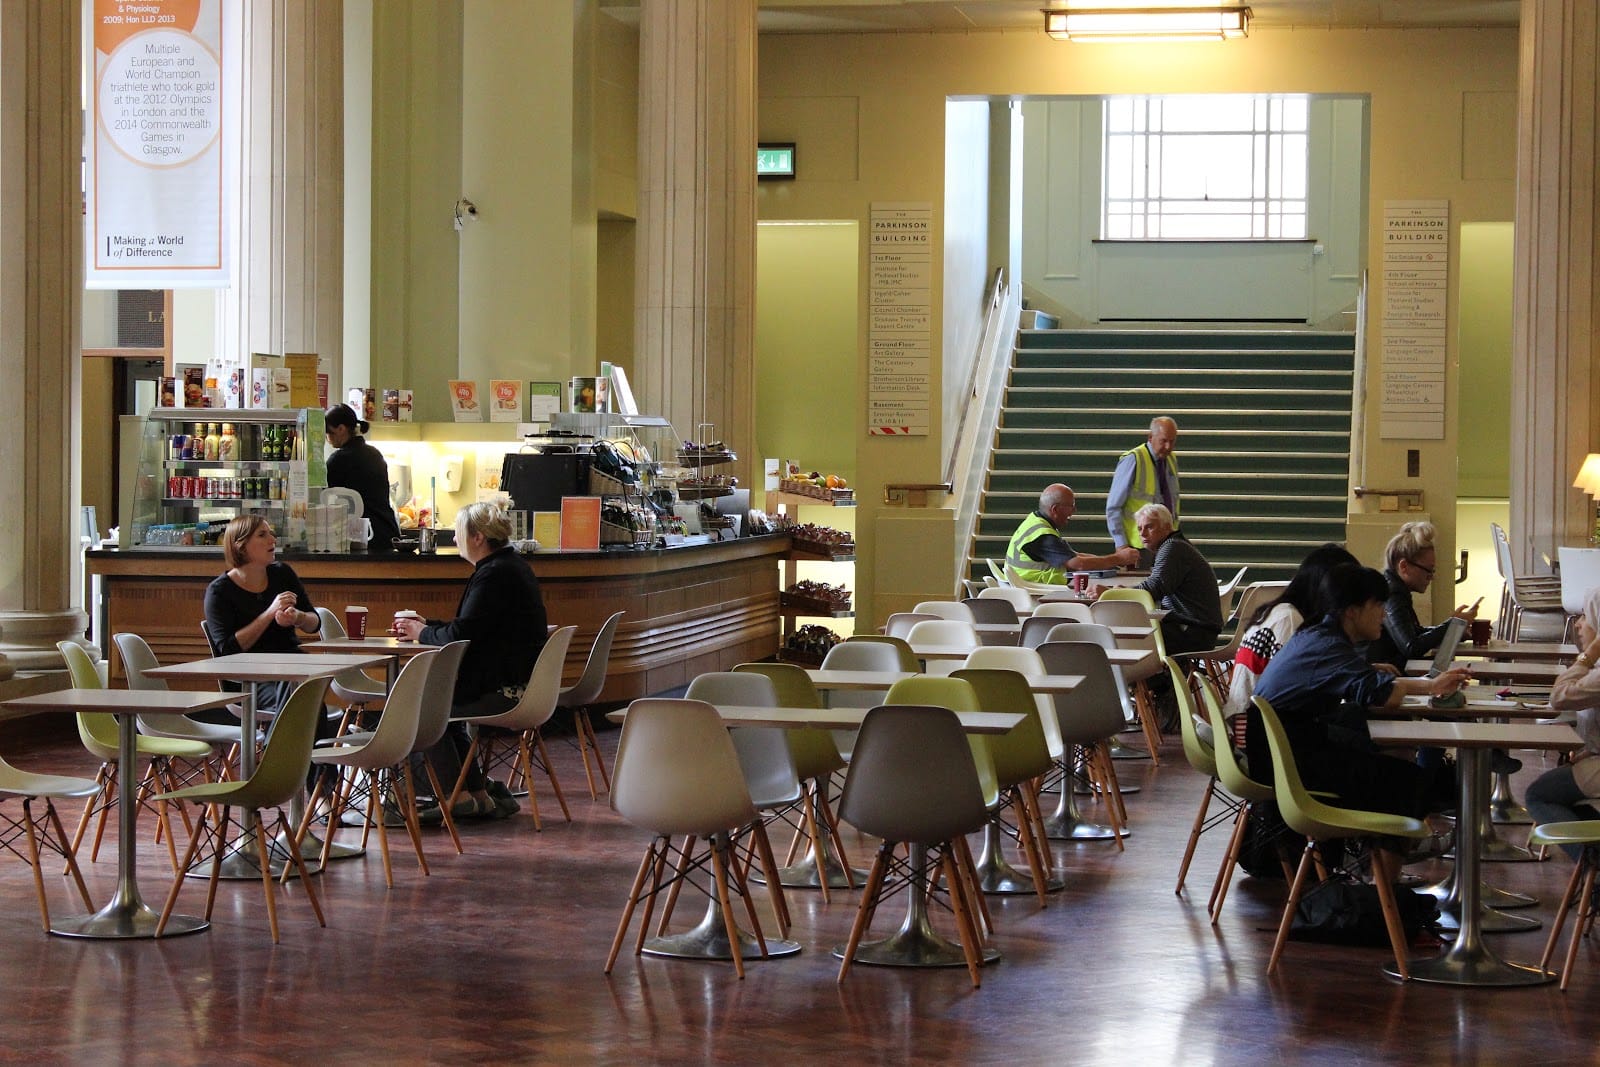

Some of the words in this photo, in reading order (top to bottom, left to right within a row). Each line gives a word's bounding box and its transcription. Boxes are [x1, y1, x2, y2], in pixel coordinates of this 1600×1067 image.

[118, 5, 124, 13] &
[126, 5, 160, 14] Physiology
[104, 16, 124, 24] 2009;
[145, 44, 180, 54] Multiple
[131, 57, 174, 67] European
[177, 56, 194, 66] and
[125, 69, 151, 79] World
[154, 69, 200, 82] Champion
[110, 82, 148, 92] triathlete
[151, 82, 170, 92] who
[174, 82, 193, 92] took
[196, 82, 215, 94] gold
[114, 96, 123, 104] at
[126, 95, 140, 104] the
[143, 95, 167, 104] 2012
[170, 94, 212, 107] Olympics
[122, 107, 129, 116] in
[132, 107, 167, 117] London
[170, 107, 187, 116] and
[190, 107, 205, 116] the
[114, 120, 137, 129] 2014
[140, 119, 211, 129] Commonwealth
[141, 132, 174, 142] Games
[176, 132, 185, 142] in
[142, 144, 183, 156] Glasgow.
[114, 236, 146, 246] Making
[157, 236, 184, 245] World
[113, 247, 124, 258] of
[126, 247, 172, 257] Difference
